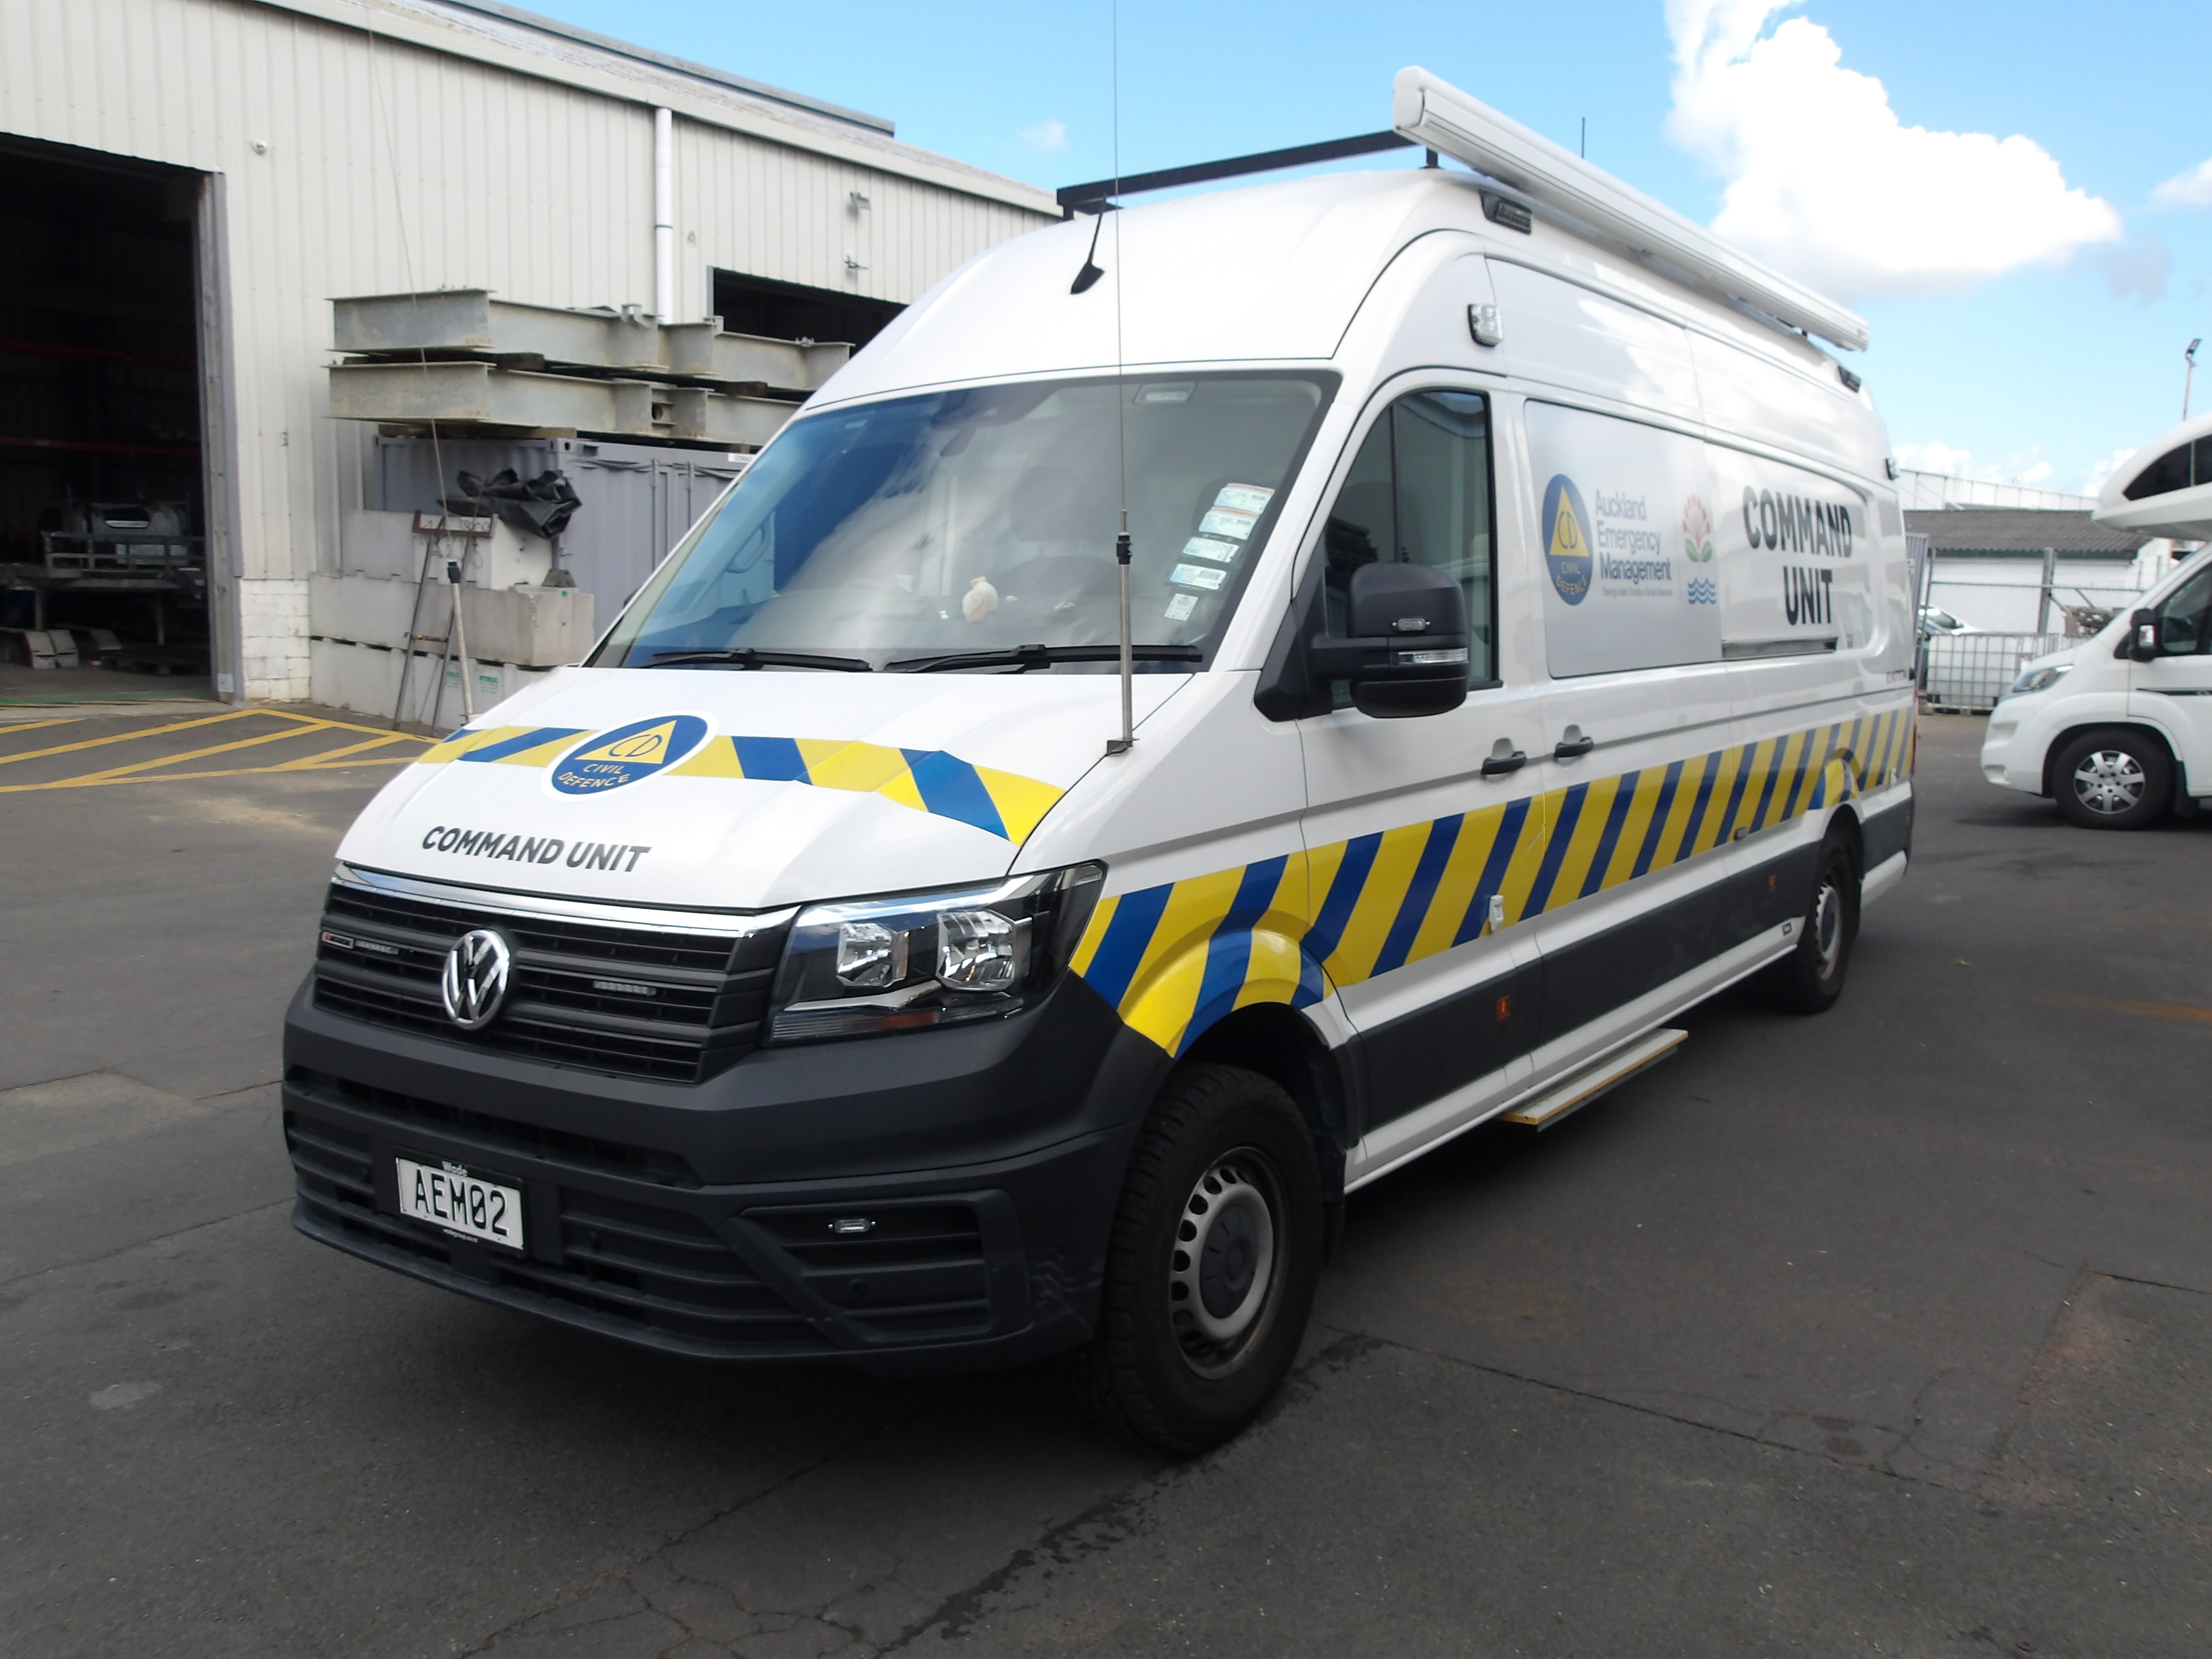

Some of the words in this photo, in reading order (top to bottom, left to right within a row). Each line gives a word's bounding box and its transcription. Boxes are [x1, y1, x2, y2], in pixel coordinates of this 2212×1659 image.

[1595, 488, 1647, 521] Auckland
[1743, 485, 1852, 558] COMMAND
[1596, 520, 1661, 555] Emergency
[1599, 552, 1672, 584] Management
[1783, 565, 1833, 626] UNIT
[608, 733, 662, 757] CD
[558, 771, 631, 788] DEFENCE
[582, 763, 625, 775] CIVIL
[422, 826, 565, 865] COMMAND
[566, 841, 652, 872] UNIT
[415, 1167, 509, 1237] AEM02
